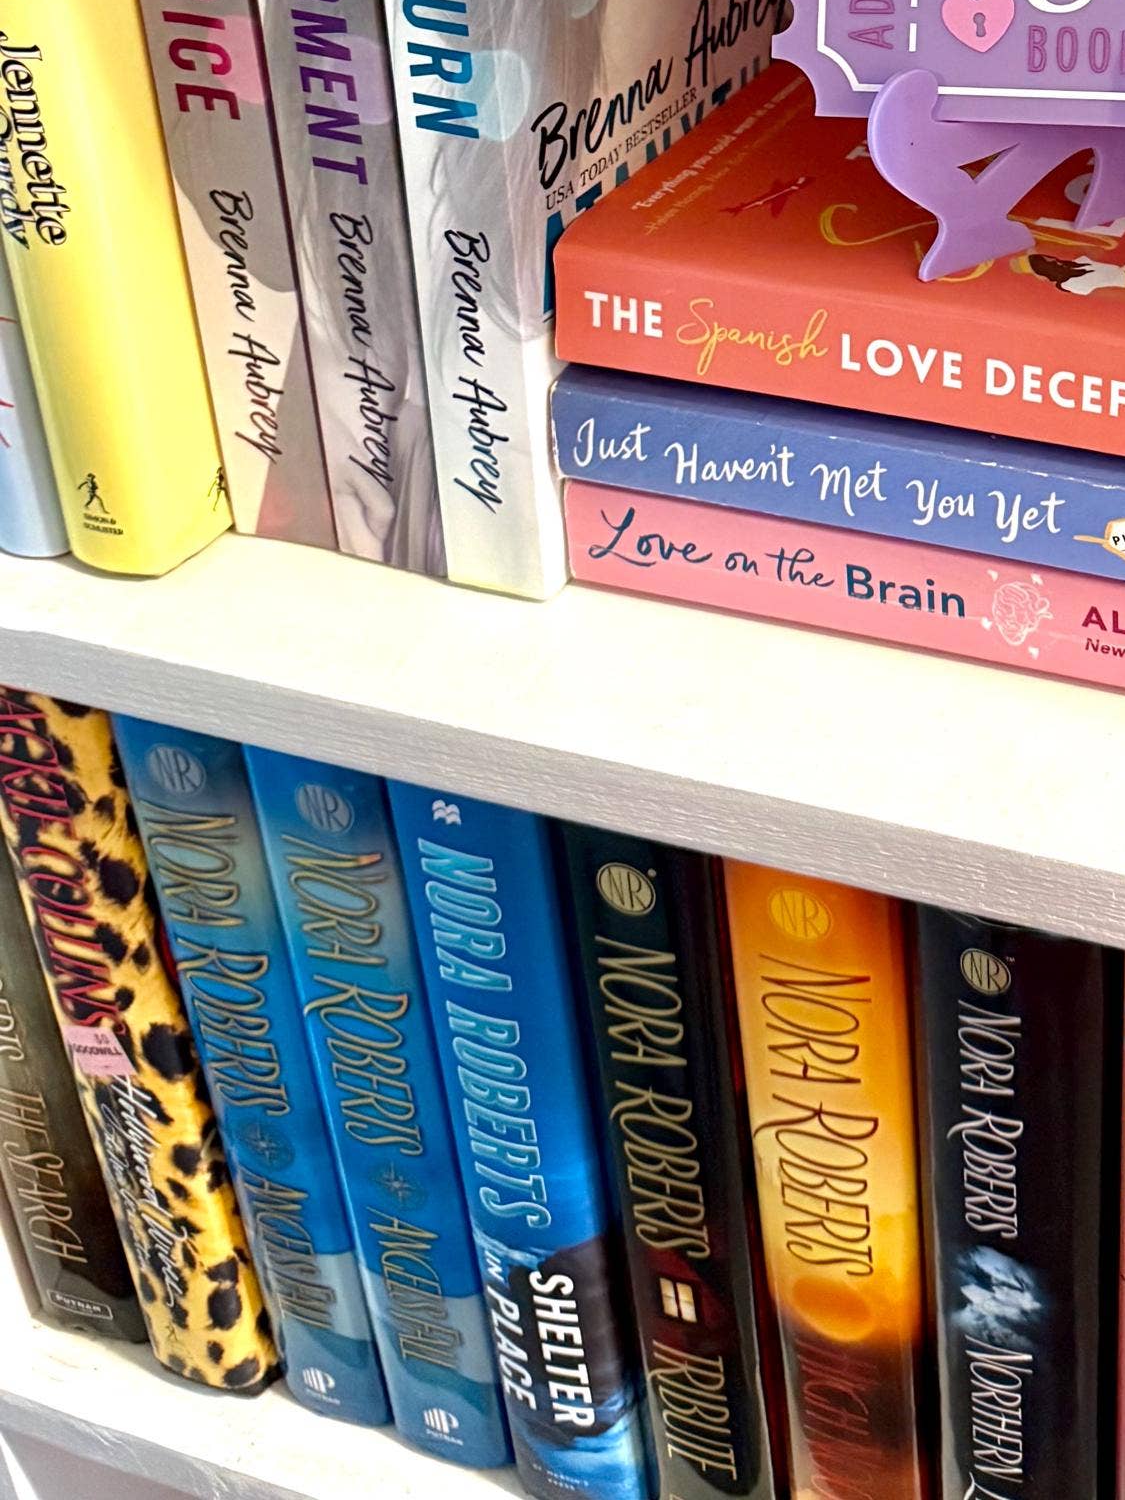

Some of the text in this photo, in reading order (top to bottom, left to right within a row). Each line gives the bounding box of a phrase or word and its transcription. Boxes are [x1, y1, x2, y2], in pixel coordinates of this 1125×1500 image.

[0, 31, 72, 246] Jennette
[531, 56, 674, 190] Brenna
[546, 87, 698, 211] USA TODAY BESTSELLER
[208, 189, 283, 464] Brenna Aubrey
[443, 229, 508, 513] Brenna Aubrey
[584, 291, 663, 339] THE
[676, 298, 830, 376] Spanish
[840, 333, 977, 389] LOVE
[573, 417, 651, 467] Just
[665, 442, 794, 487] Haven't
[906, 479, 976, 526] You
[986, 490, 1066, 543] Yet
[589, 506, 967, 619] Love on the Brain
[417, 835, 554, 1233] NORA ROBERTS
[759, 954, 873, 1085] NORA
[6, 1151, 88, 1264] SEARCH
[753, 1093, 880, 1278] ROBERTS
[484, 1250, 537, 1411] IN PLACE
[529, 1270, 596, 1428] SHELTER
[649, 1340, 737, 1482] TRIBUTE
[964, 1335, 1033, 1484] NORTHERN
